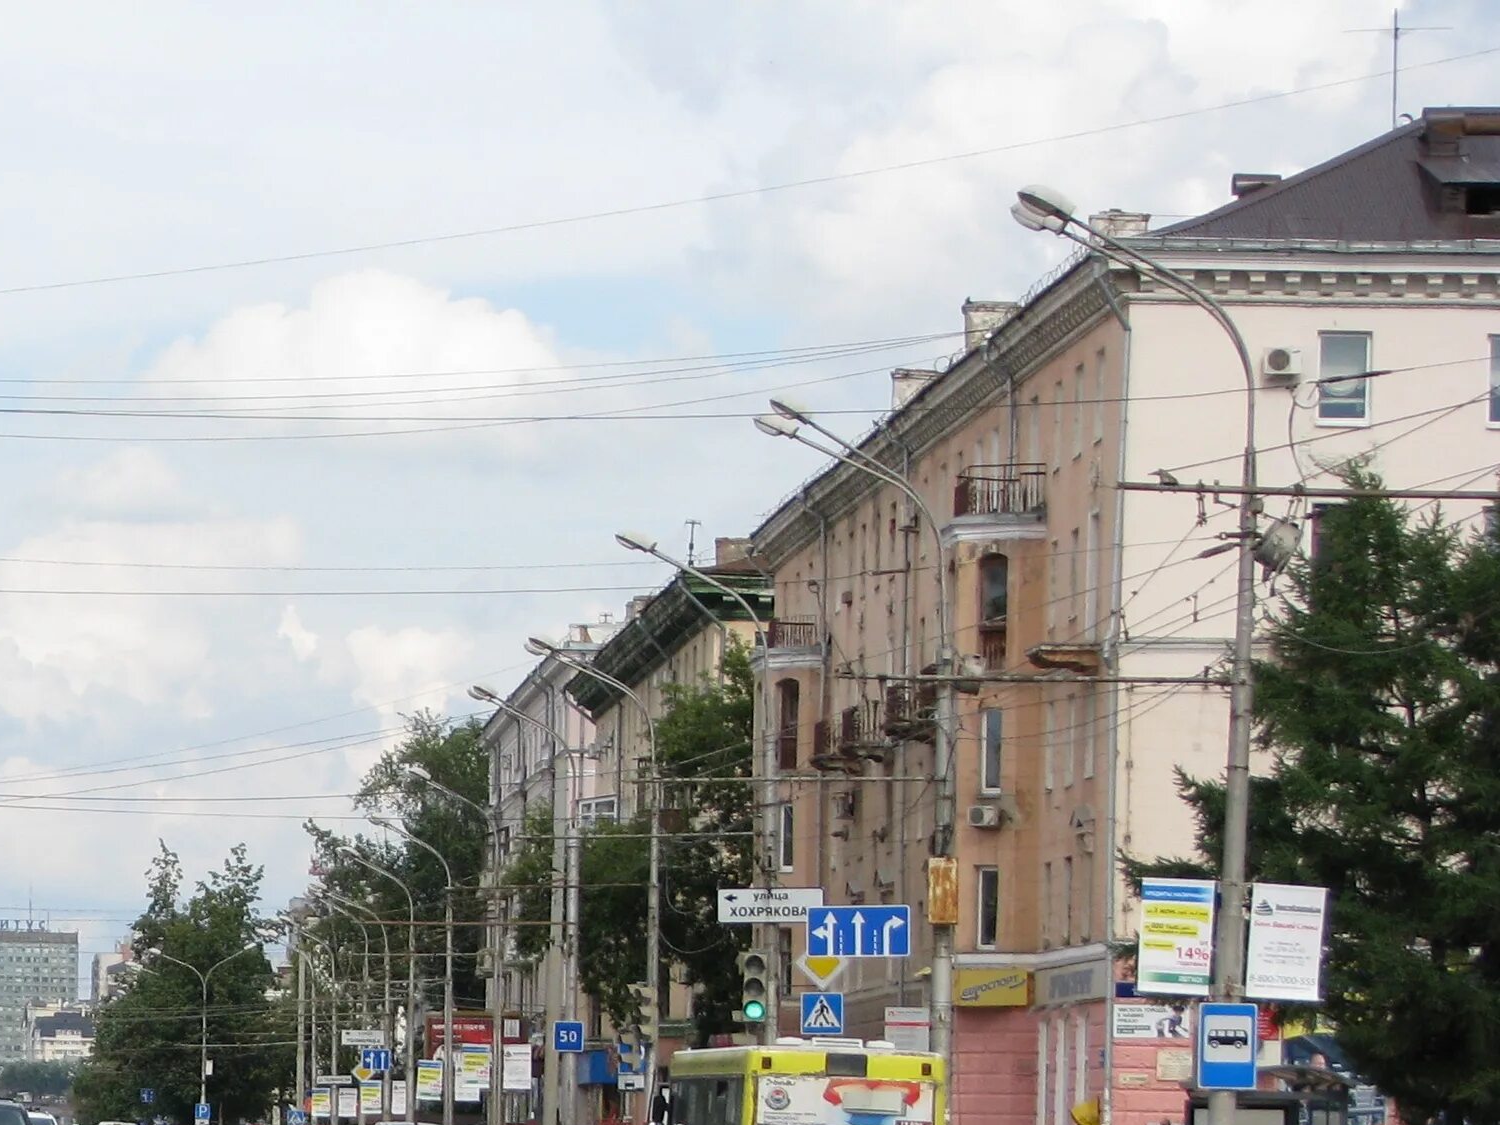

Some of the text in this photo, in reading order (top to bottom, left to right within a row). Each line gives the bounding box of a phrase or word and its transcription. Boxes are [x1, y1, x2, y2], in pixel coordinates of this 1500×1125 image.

[752, 890, 790, 902] улица
[729, 906, 808, 918] ХОХРЯКОВА
[559, 1031, 577, 1042] 50
